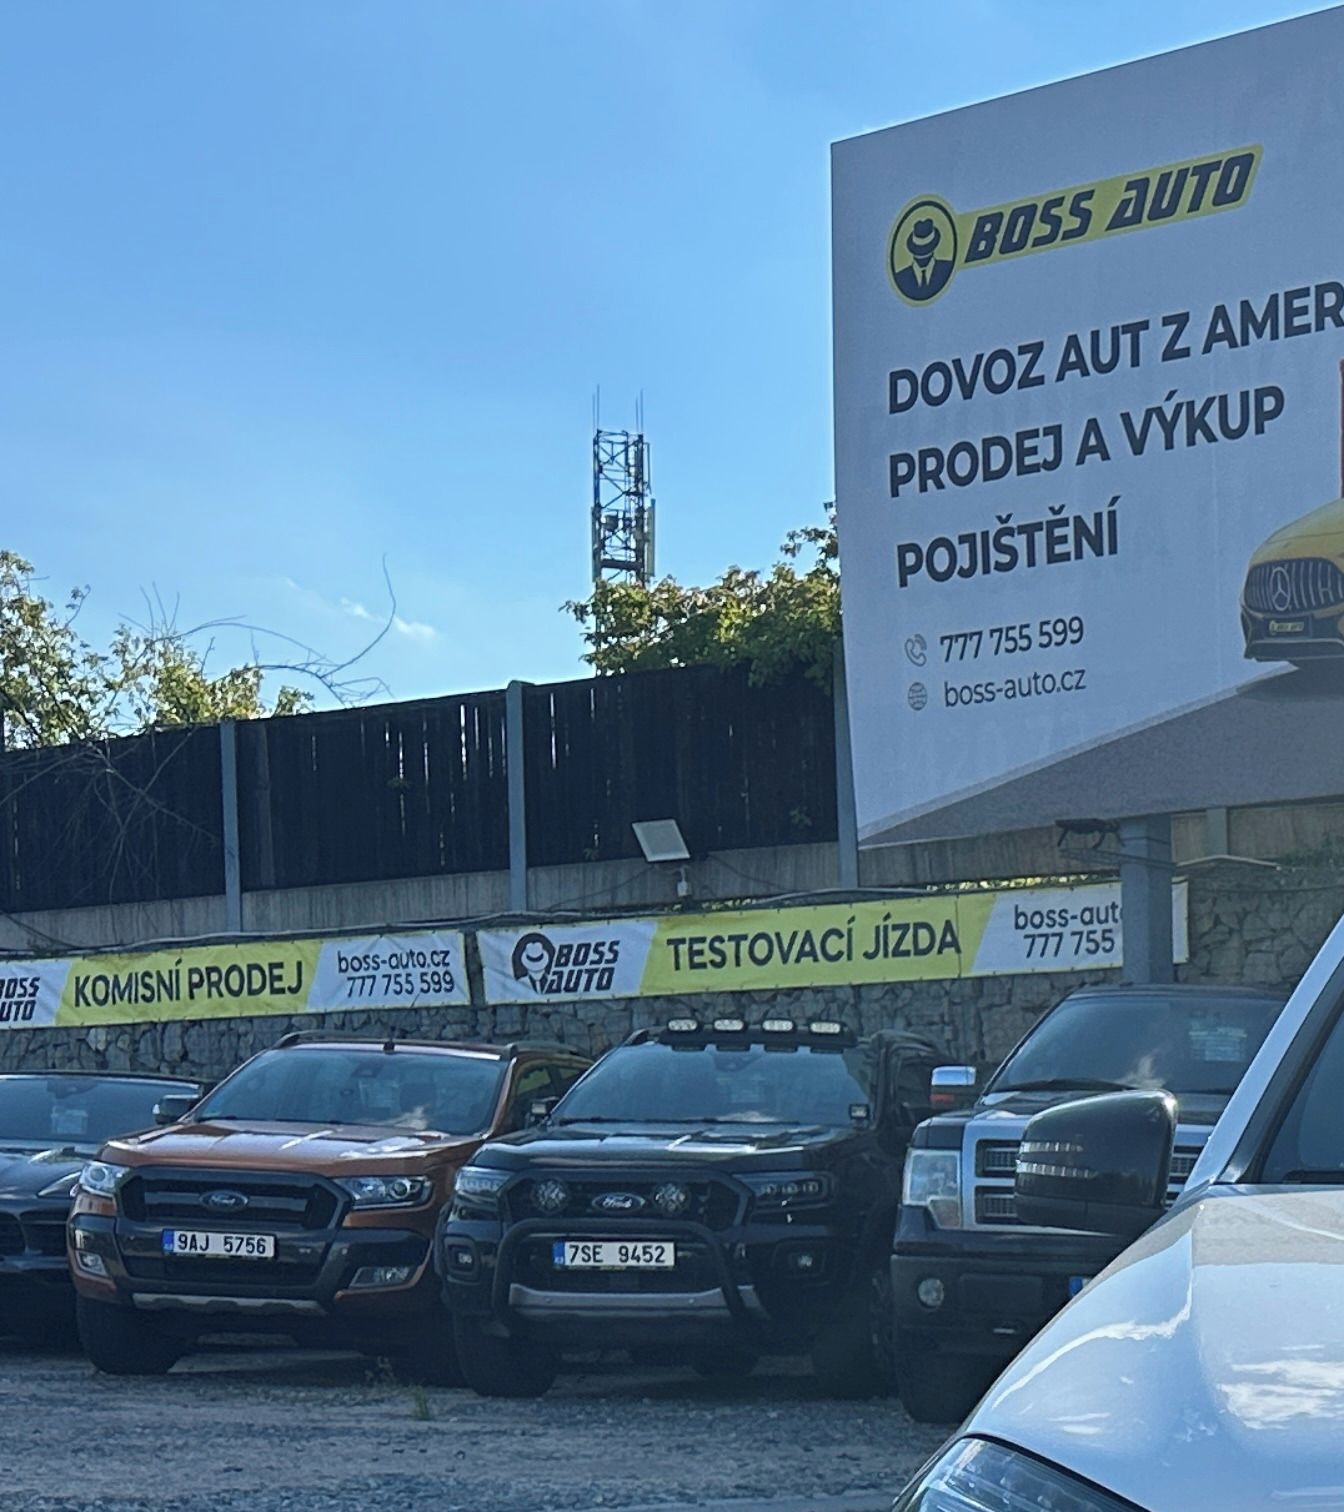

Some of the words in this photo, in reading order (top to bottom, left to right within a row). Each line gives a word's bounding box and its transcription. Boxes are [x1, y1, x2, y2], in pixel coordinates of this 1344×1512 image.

[964, 189, 1096, 264] BOSS
[1105, 152, 1256, 231] AUTO
[888, 341, 1045, 415] DOVOZ
[1055, 320, 1149, 382] AUT
[1161, 310, 1191, 362] Z
[889, 423, 1064, 498] PRODEJ
[1076, 416, 1111, 465] A
[1120, 386, 1285, 456] VÝKUP
[897, 495, 1122, 588] POJIŠTĚNÍ
[939, 630, 984, 663] 777
[989, 622, 1033, 656] 755
[1038, 616, 1084, 649] 599
[943, 668, 1087, 709] boss-auto.cz
[1014, 901, 1123, 930] boss-aut
[554, 940, 620, 967] BOSS
[666, 916, 854, 971] TESTOVACÍ
[862, 913, 962, 961] JÍZDA
[1024, 932, 1063, 958] 777
[1070, 929, 1115, 955] 755
[337, 949, 451, 973] boss-auto.cz
[74, 958, 184, 1008] KOMISNÍ
[187, 960, 303, 1000] PRODEJ
[346, 975, 376, 998] 777
[381, 973, 414, 996] 755
[419, 970, 455, 993] 599
[544, 967, 615, 995] AUTO
[0, 1000, 36, 1021] UTO
[178, 1233, 210, 1252] 9AJ
[223, 1235, 267, 1254] 5756
[569, 1244, 603, 1264] 7SE
[618, 1245, 666, 1263] 9452
